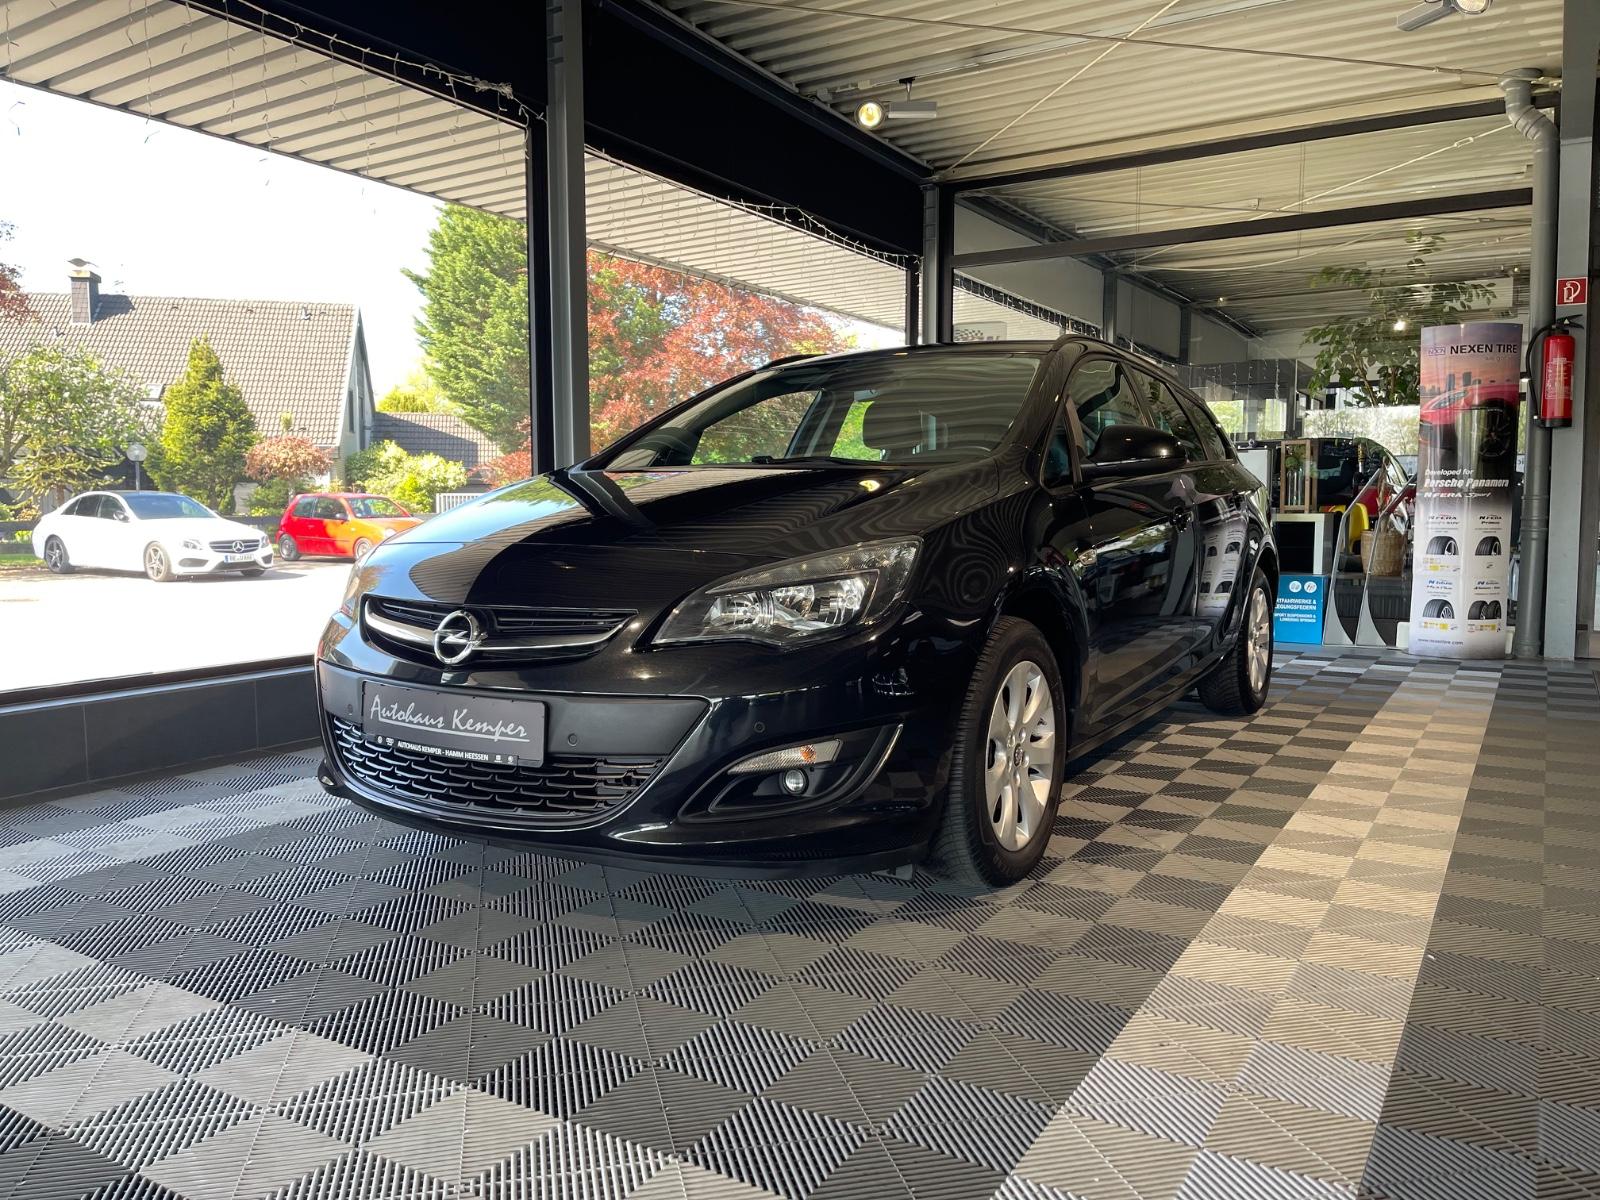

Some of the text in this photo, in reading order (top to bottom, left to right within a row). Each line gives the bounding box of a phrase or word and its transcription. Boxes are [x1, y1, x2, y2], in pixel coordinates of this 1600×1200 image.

[1450, 344, 1494, 354] NEXEN
[1496, 344, 1518, 354] TIRE
[1424, 469, 1462, 477] Developed
[1424, 478, 1464, 488] Porsche
[370, 694, 528, 742] Autohaus Kemper
[397, 741, 422, 752] AUTOHAUS
[422, 744, 442, 755] KEMPER
[445, 750, 464, 758] HAMM
[464, 752, 489, 761] HEESSEN
